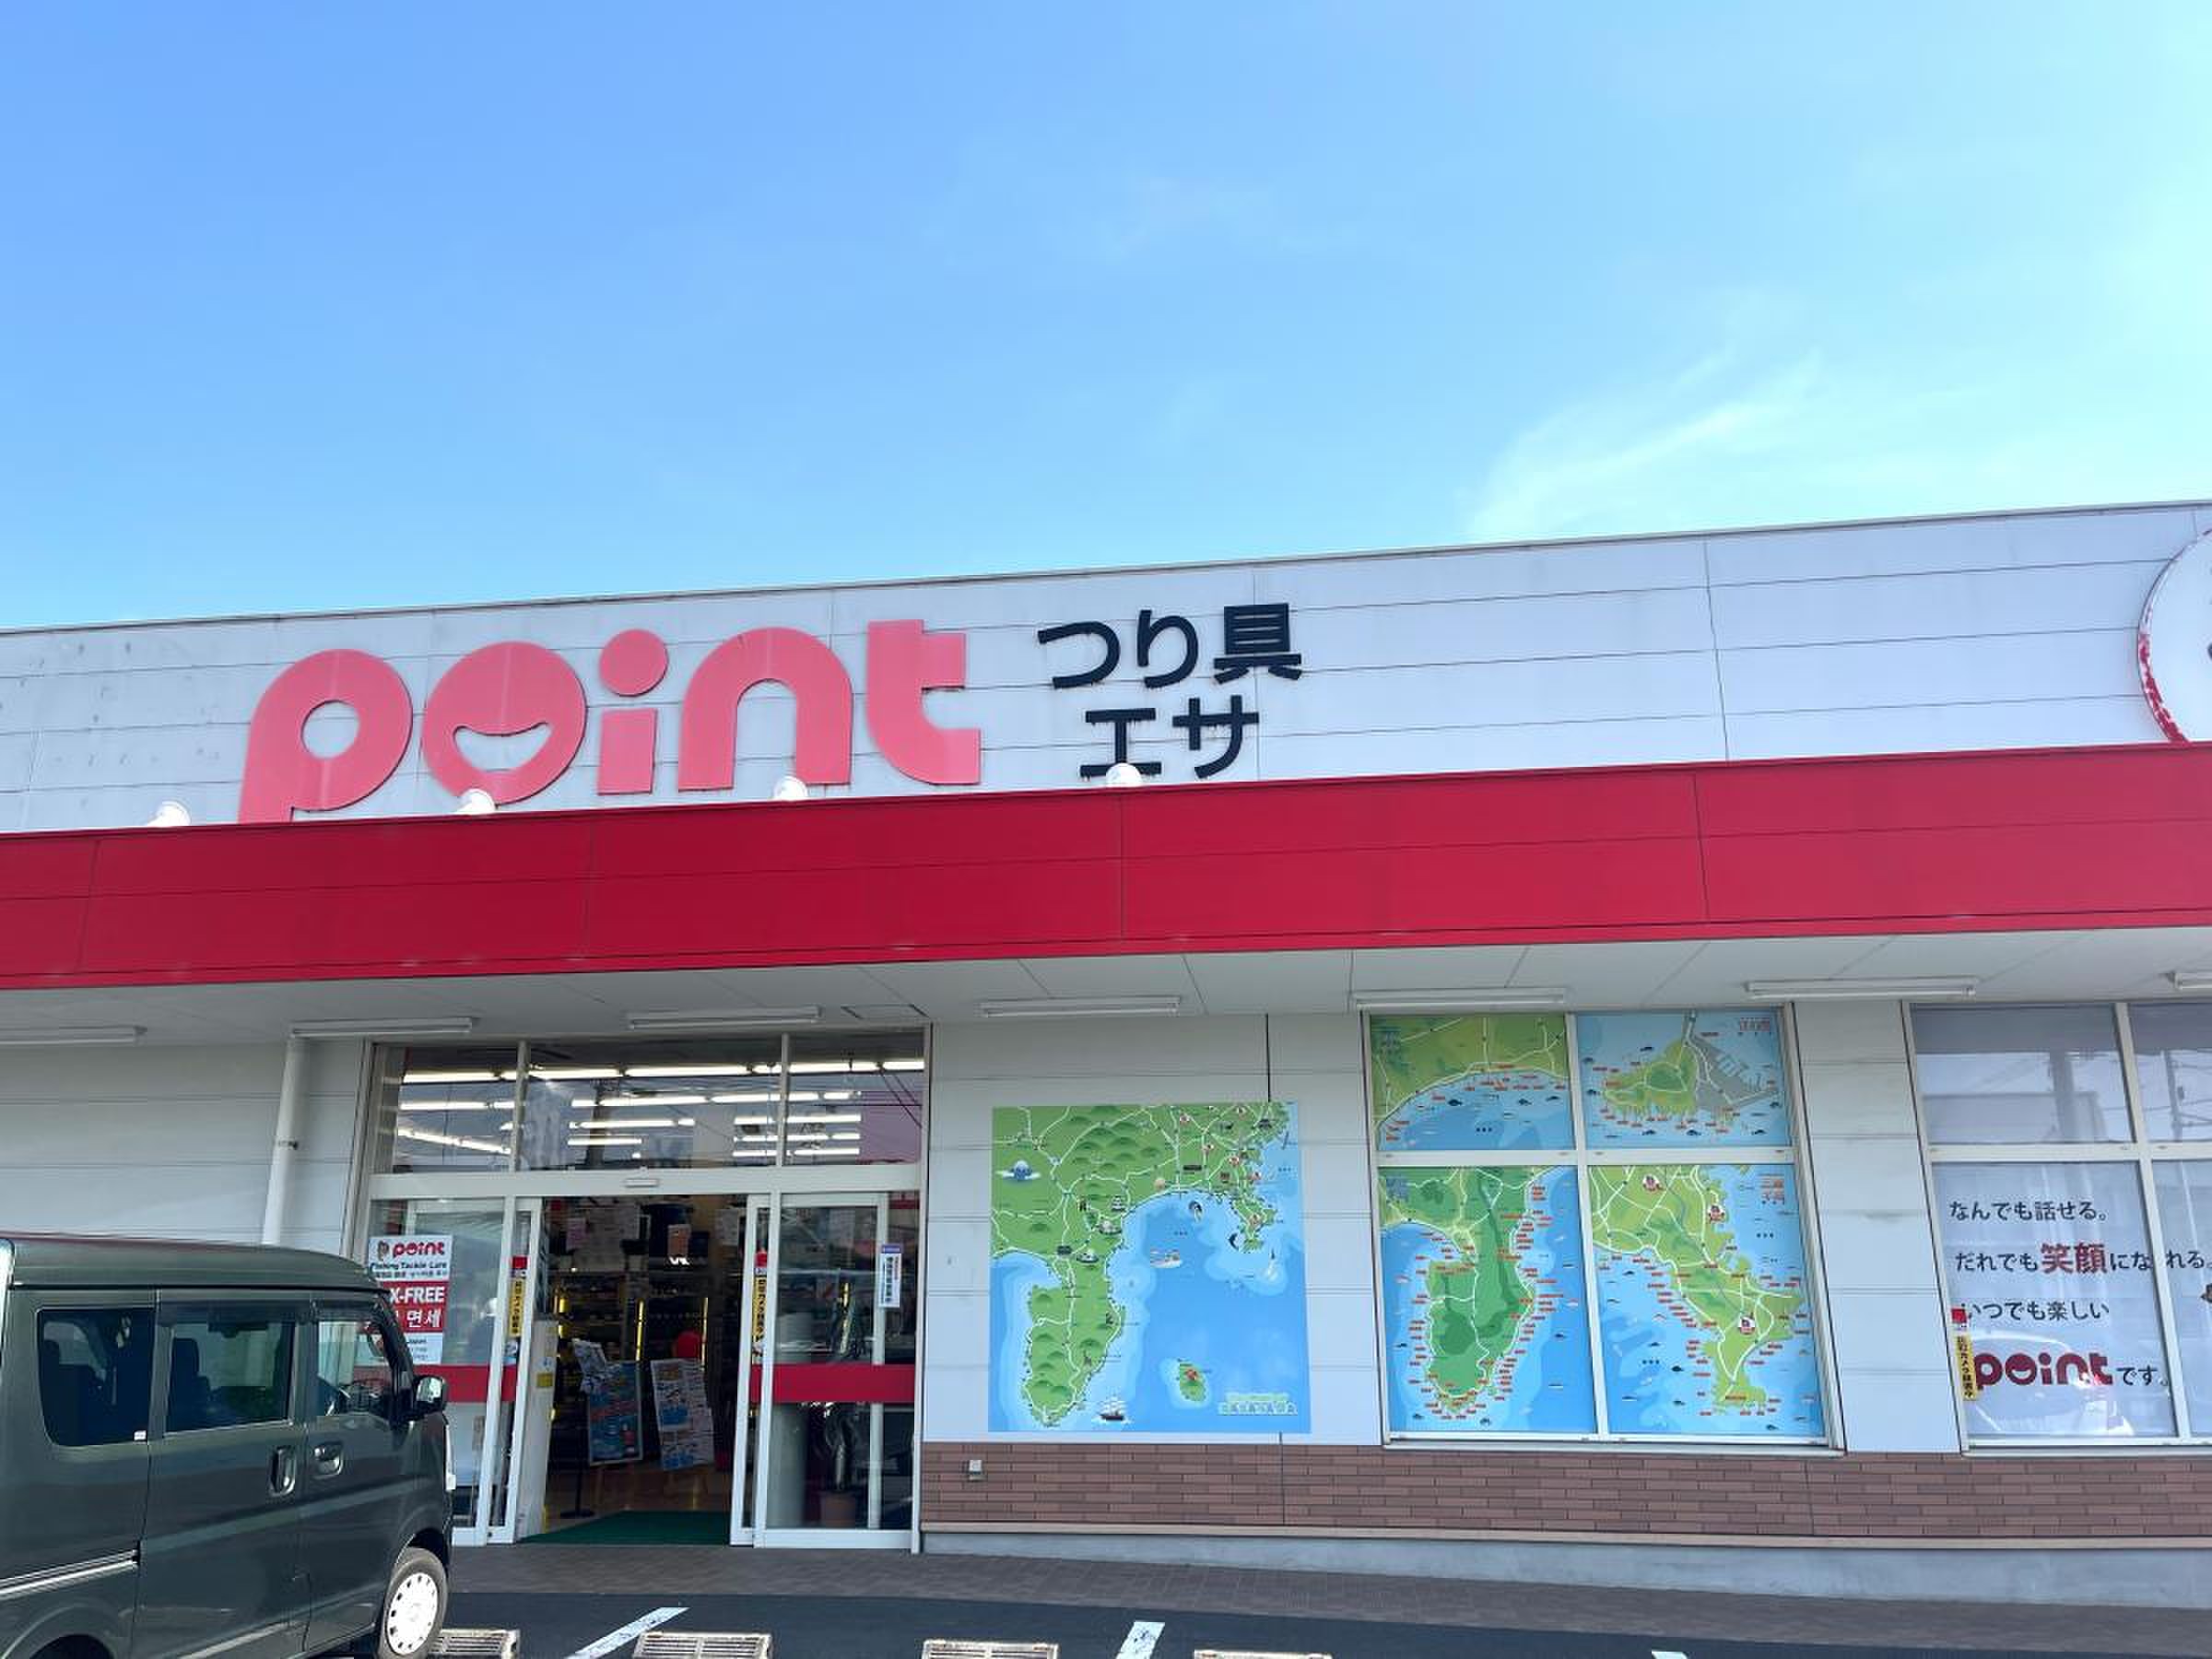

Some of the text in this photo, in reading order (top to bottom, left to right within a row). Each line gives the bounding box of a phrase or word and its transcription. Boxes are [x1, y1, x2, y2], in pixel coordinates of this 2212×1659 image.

[1038, 603, 1301, 689] つり具
[239, 619, 981, 822] point
[1080, 695, 1260, 780] エサ
[1949, 1201, 2107, 1221] なんでも話せる。
[393, 1241, 445, 1258] point
[389, 1286, 445, 1304] X-FREE
[1973, 1352, 2113, 1391] point
